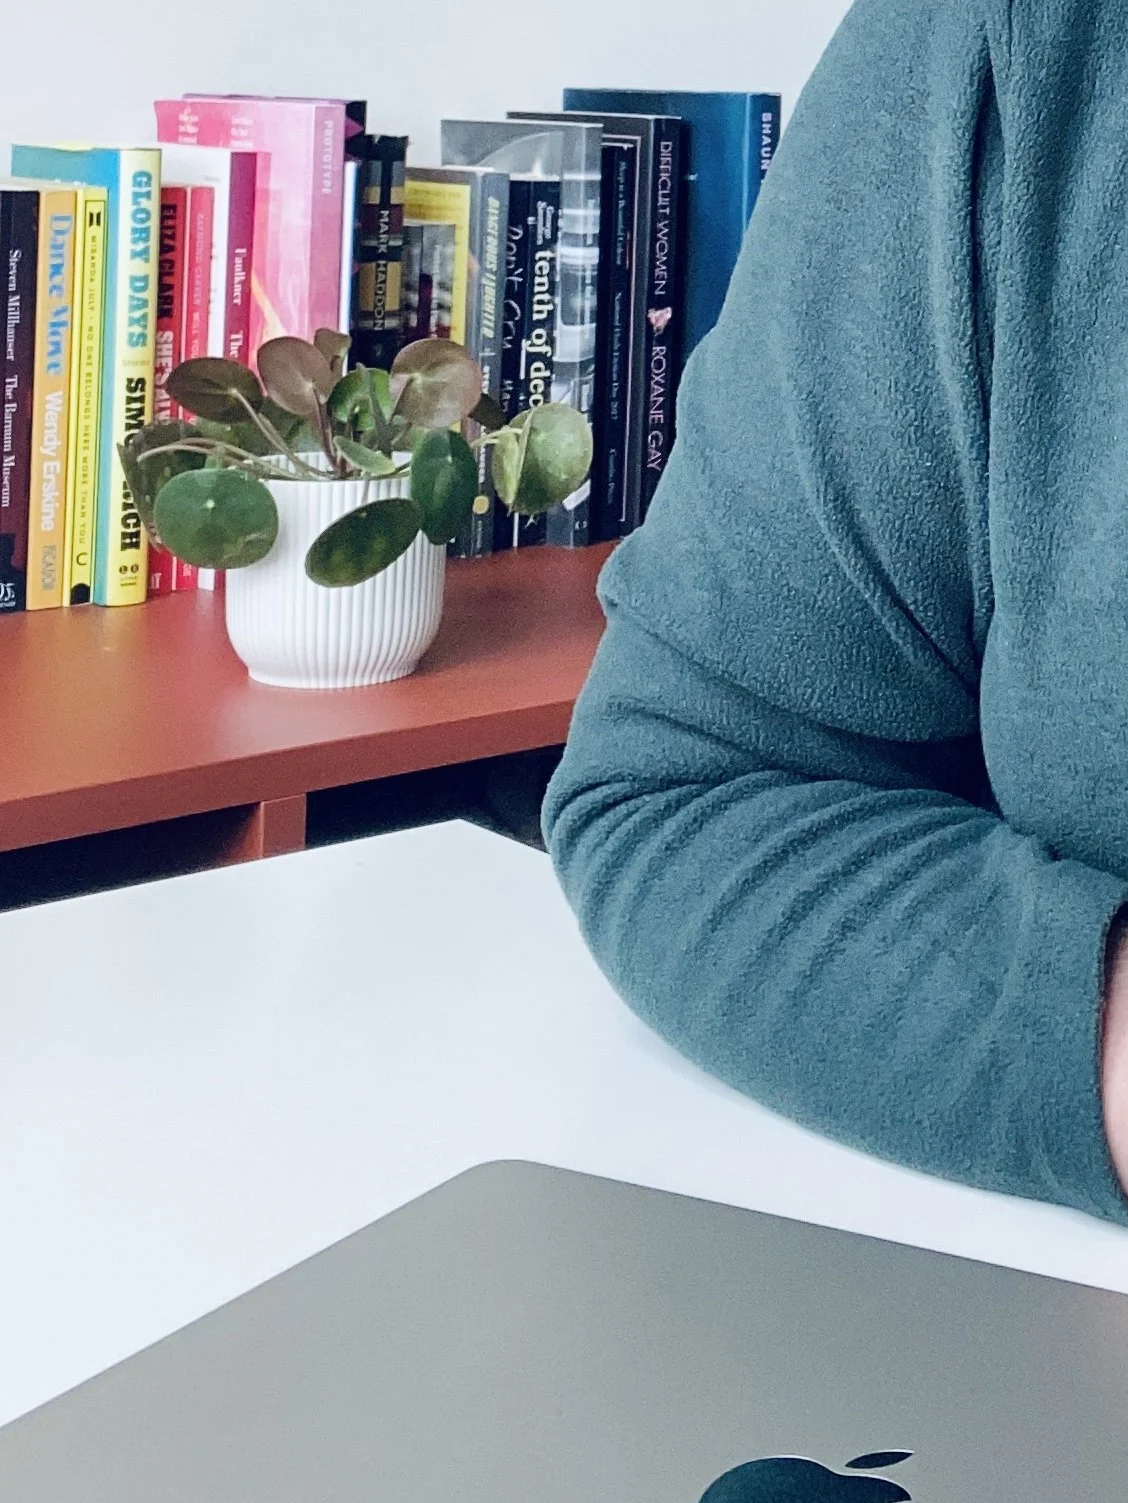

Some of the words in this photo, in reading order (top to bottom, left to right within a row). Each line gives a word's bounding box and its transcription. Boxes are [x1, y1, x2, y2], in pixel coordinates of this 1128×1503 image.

[322, 120, 334, 194] PROTOTYPE
[760, 112, 773, 170] SHAUN
[656, 141, 673, 214] DIFFICULT
[129, 170, 153, 264] GLORY
[160, 203, 177, 254] ELIZA
[377, 210, 390, 253] MARK
[8, 249, 22, 291] Steven
[47, 216, 73, 296] Dance
[88, 235, 97, 284] MIRANDA
[233, 247, 247, 306] Faulkner
[654, 221, 669, 295] WOMEN
[87, 288, 96, 312] JULY
[158, 258, 175, 319] CLARK
[373, 261, 387, 330] HADDON
[532, 250, 554, 321] tenth
[6, 295, 20, 361] Millhauser
[86, 325, 95, 340] NO
[126, 275, 150, 348] DAYS
[45, 305, 72, 376] Move
[85, 346, 94, 367] ONE
[229, 330, 244, 358] The
[526, 328, 552, 357] of
[4, 375, 18, 400] The
[83, 372, 93, 420] BELONGS
[529, 361, 550, 408] dec
[650, 346, 667, 424] ROXANE
[3, 403, 18, 452] Barnum
[39, 391, 64, 455] Wendy
[82, 425, 91, 451] HERE
[81, 456, 89, 485] MORE
[646, 431, 663, 471] GAY
[1, 456, 16, 507] Museum
[40, 461, 61, 531] Erskine
[79, 489, 88, 518] THAN
[78, 523, 87, 544] YOU
[120, 481, 142, 551] ICH
